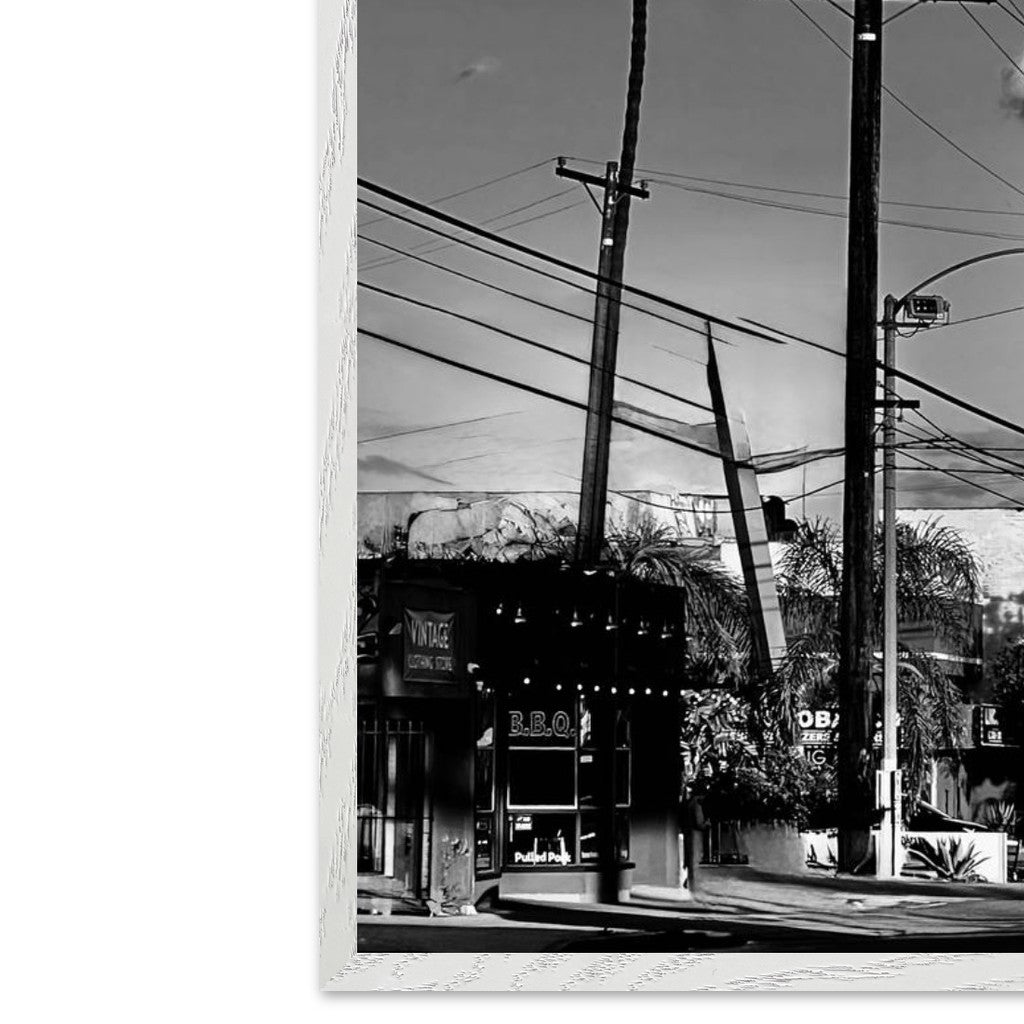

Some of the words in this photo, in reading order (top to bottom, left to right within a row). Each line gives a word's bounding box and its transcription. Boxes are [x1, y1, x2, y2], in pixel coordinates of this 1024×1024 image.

[410, 619, 449, 649] VINTAGE
[508, 710, 577, 738] B.B.Q.
[514, 851, 547, 863] Pulled
